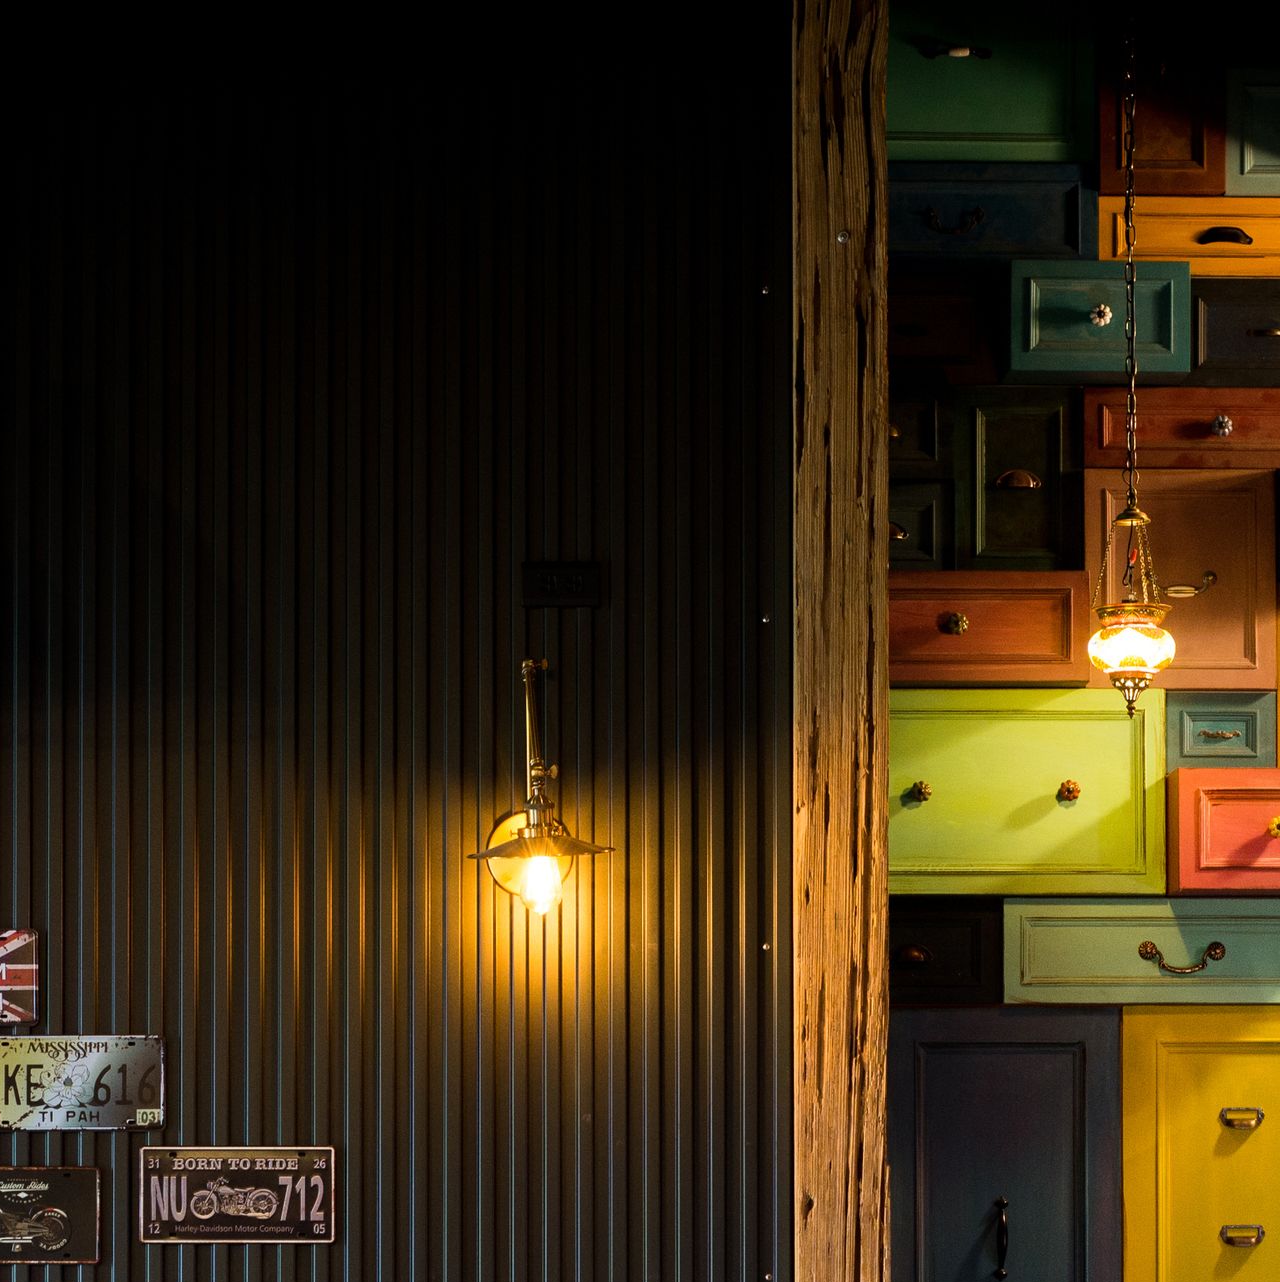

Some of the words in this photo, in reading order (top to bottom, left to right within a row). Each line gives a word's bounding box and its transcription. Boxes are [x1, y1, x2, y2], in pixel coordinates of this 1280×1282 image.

[27, 1041, 109, 1062] MISSISSIPPI
[91, 1064, 157, 1107] 616
[39, 1111, 54, 1122] TI
[66, 1111, 100, 1122] PAH
[141, 1111, 156, 1123] 03
[147, 1158, 160, 1169] 31
[172, 1158, 223, 1170] BORN
[228, 1158, 251, 1170] TO
[254, 1158, 299, 1170] RIDE
[313, 1158, 326, 1169] 26
[26, 1181, 49, 1190] Rides
[150, 1176, 188, 1222] NU
[278, 1175, 324, 1222] 712
[148, 1223, 161, 1234] 12
[259, 1225, 295, 1234] Company
[313, 1223, 326, 1234] 05
